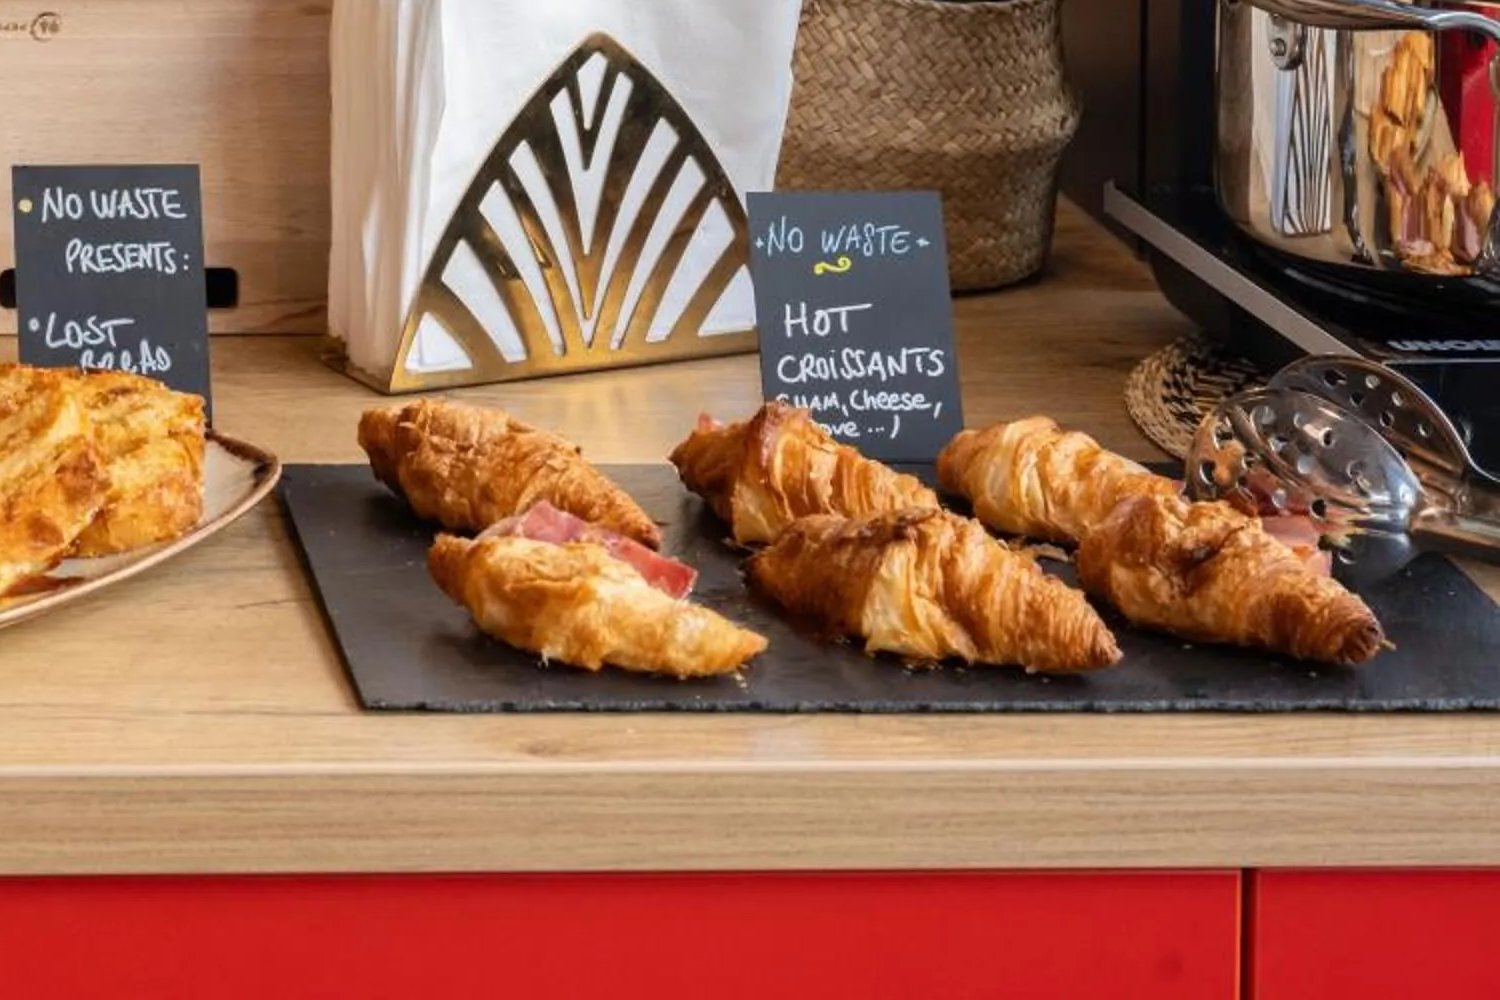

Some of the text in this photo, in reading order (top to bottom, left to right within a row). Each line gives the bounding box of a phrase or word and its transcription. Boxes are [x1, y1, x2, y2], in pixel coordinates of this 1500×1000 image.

[41, 186, 188, 223] NO WASTE
[767, 215, 911, 257] NO WASTE
[45, 312, 136, 349] LOST
[784, 301, 873, 338] HOT
